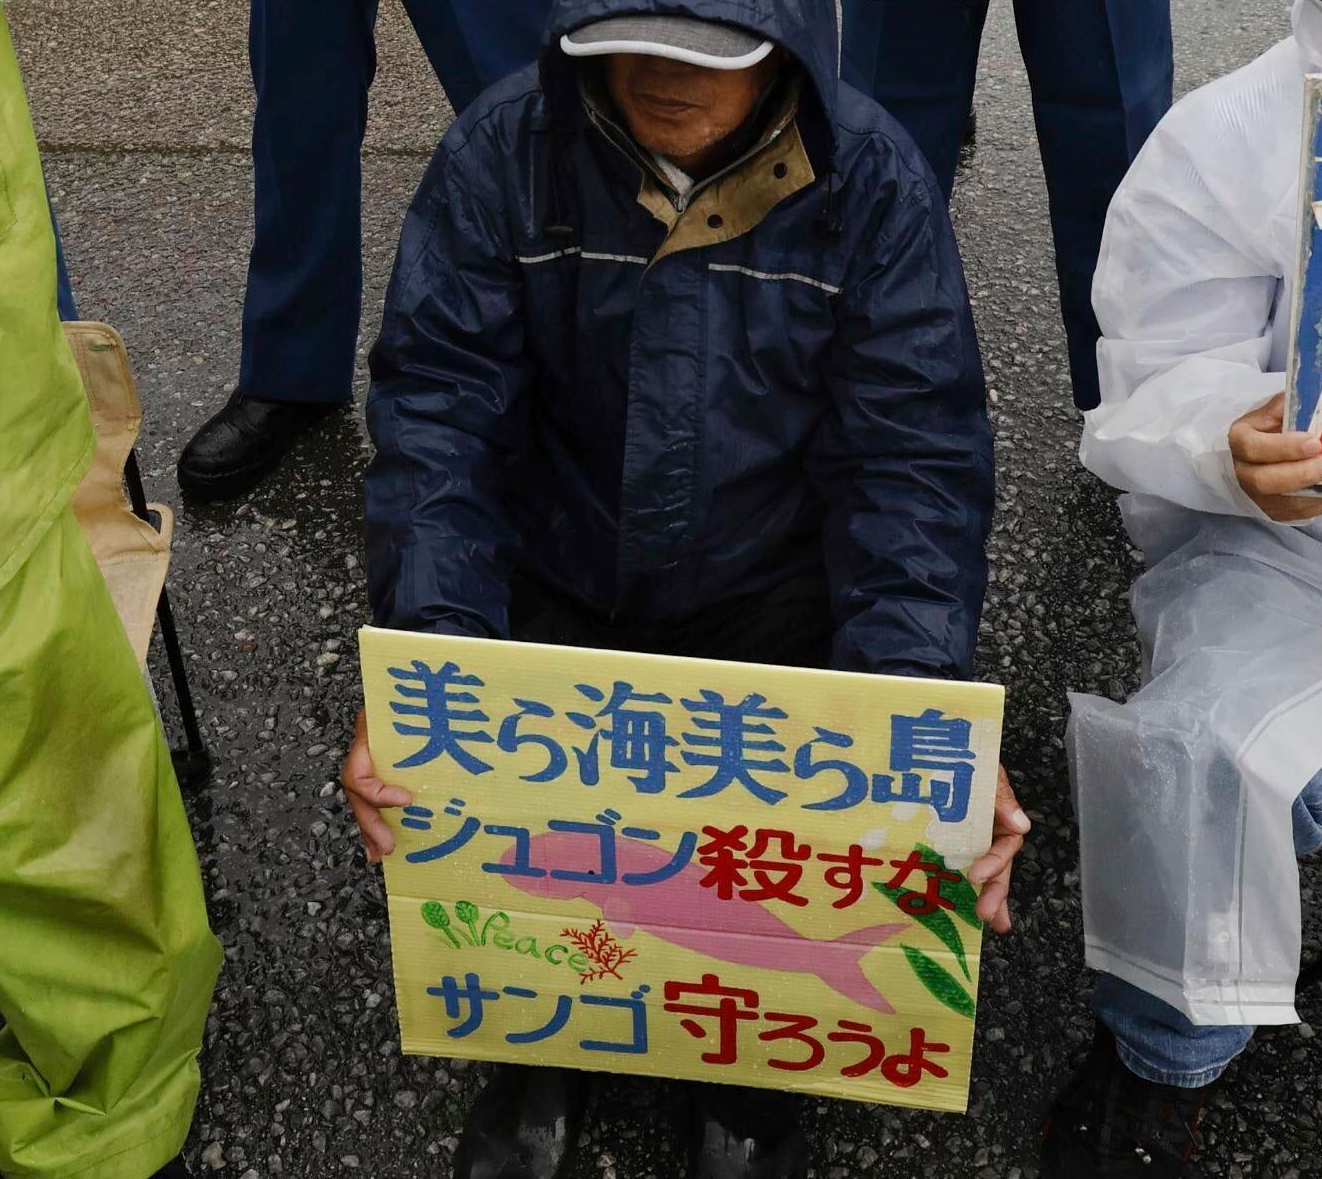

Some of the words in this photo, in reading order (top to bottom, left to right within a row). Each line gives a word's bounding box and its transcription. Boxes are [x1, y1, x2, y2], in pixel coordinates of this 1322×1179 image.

[386, 658, 976, 823] 美ら海美ら島
[480, 910, 586, 973] Peace
